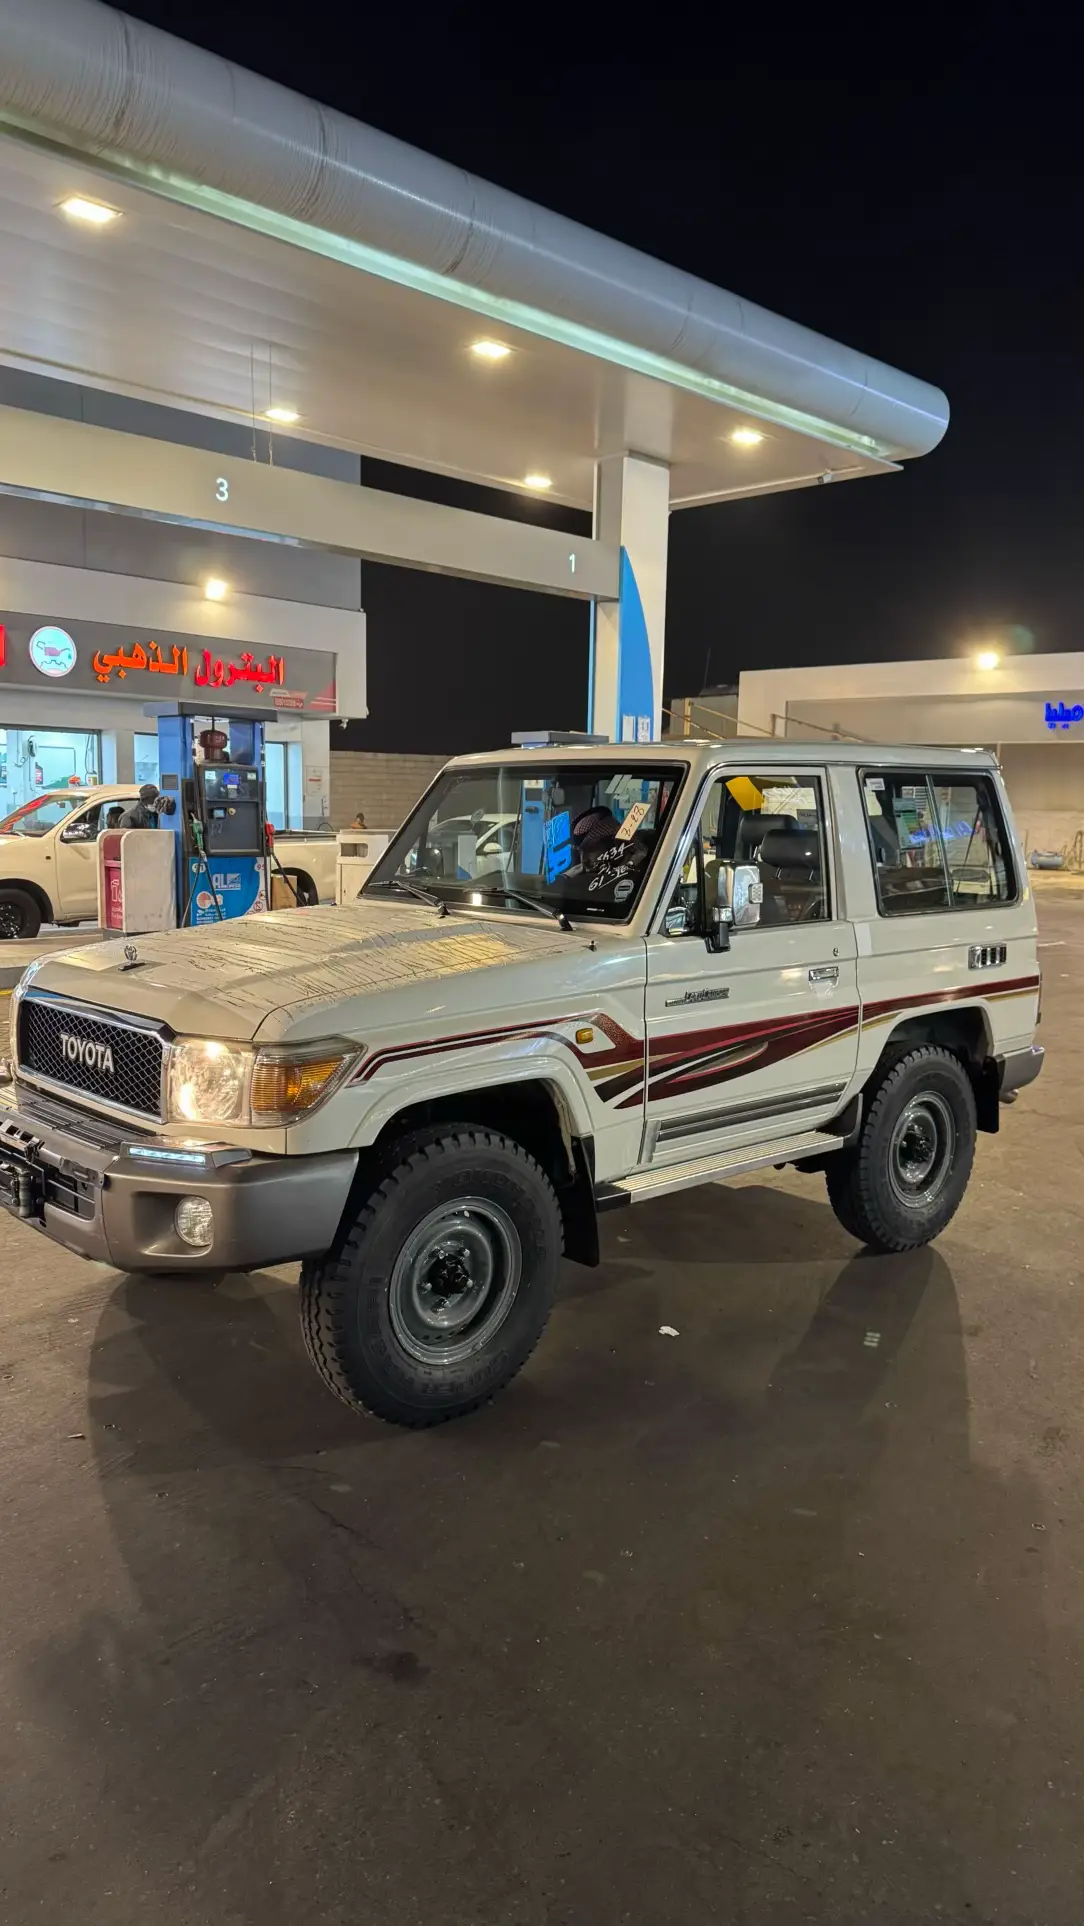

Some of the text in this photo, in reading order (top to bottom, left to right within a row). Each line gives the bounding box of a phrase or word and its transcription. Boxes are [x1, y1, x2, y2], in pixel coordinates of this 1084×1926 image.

[215, 477, 229, 502] 3
[569, 553, 576, 573] 1
[93, 641, 284, 693] البترول الذهبي
[60, 1034, 115, 1073] TOYOTA
